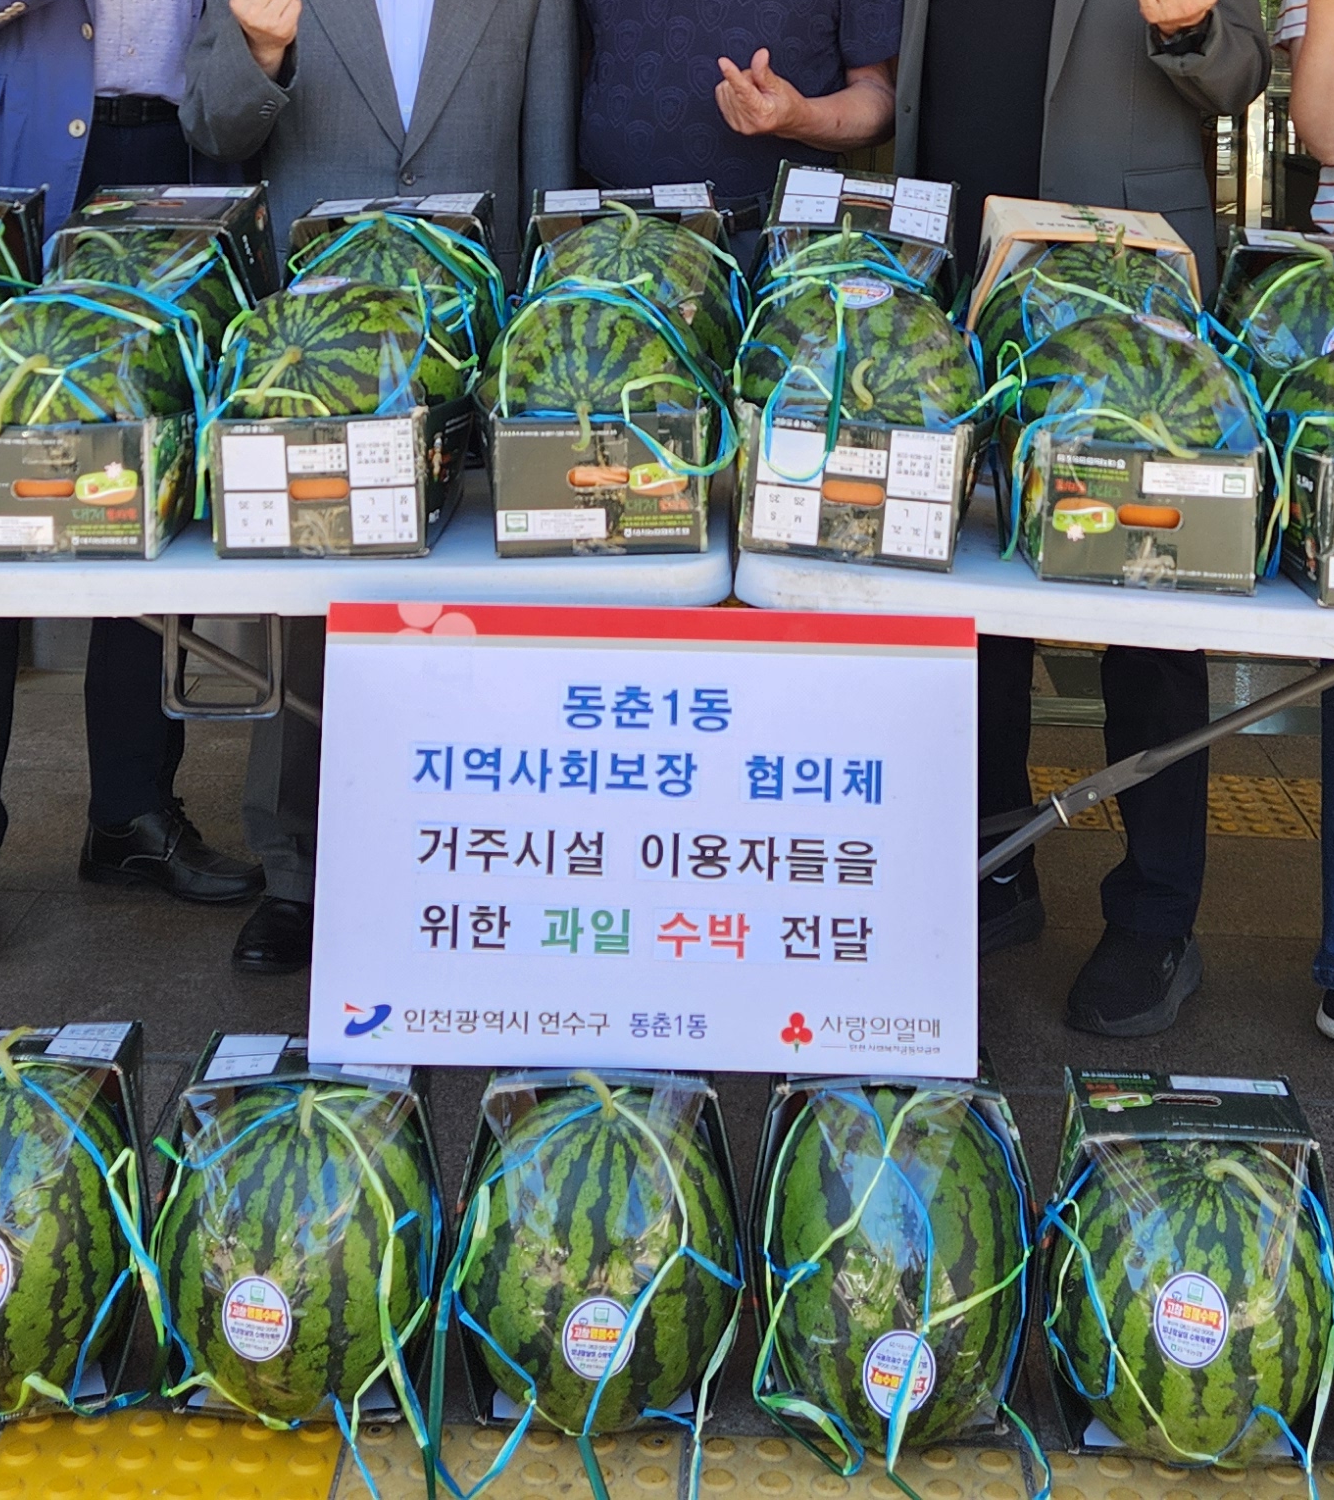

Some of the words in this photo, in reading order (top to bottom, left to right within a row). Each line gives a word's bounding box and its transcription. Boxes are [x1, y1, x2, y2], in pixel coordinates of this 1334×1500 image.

[562, 684, 734, 733] 동춘1동
[412, 745, 698, 798] 지역사회보장
[744, 754, 885, 805] 협의체
[416, 826, 606, 877] 거주시설
[639, 831, 878, 886] 이용자들을
[419, 904, 511, 952] 위한
[539, 907, 632, 956] 과일
[656, 910, 751, 960] 수박
[779, 914, 873, 964] 전달
[402, 1008, 530, 1036] 인천광역시
[537, 1011, 611, 1038] 연수구
[628, 1012, 708, 1039] 동춘1동
[820, 1015, 941, 1044] 사랑의열매
